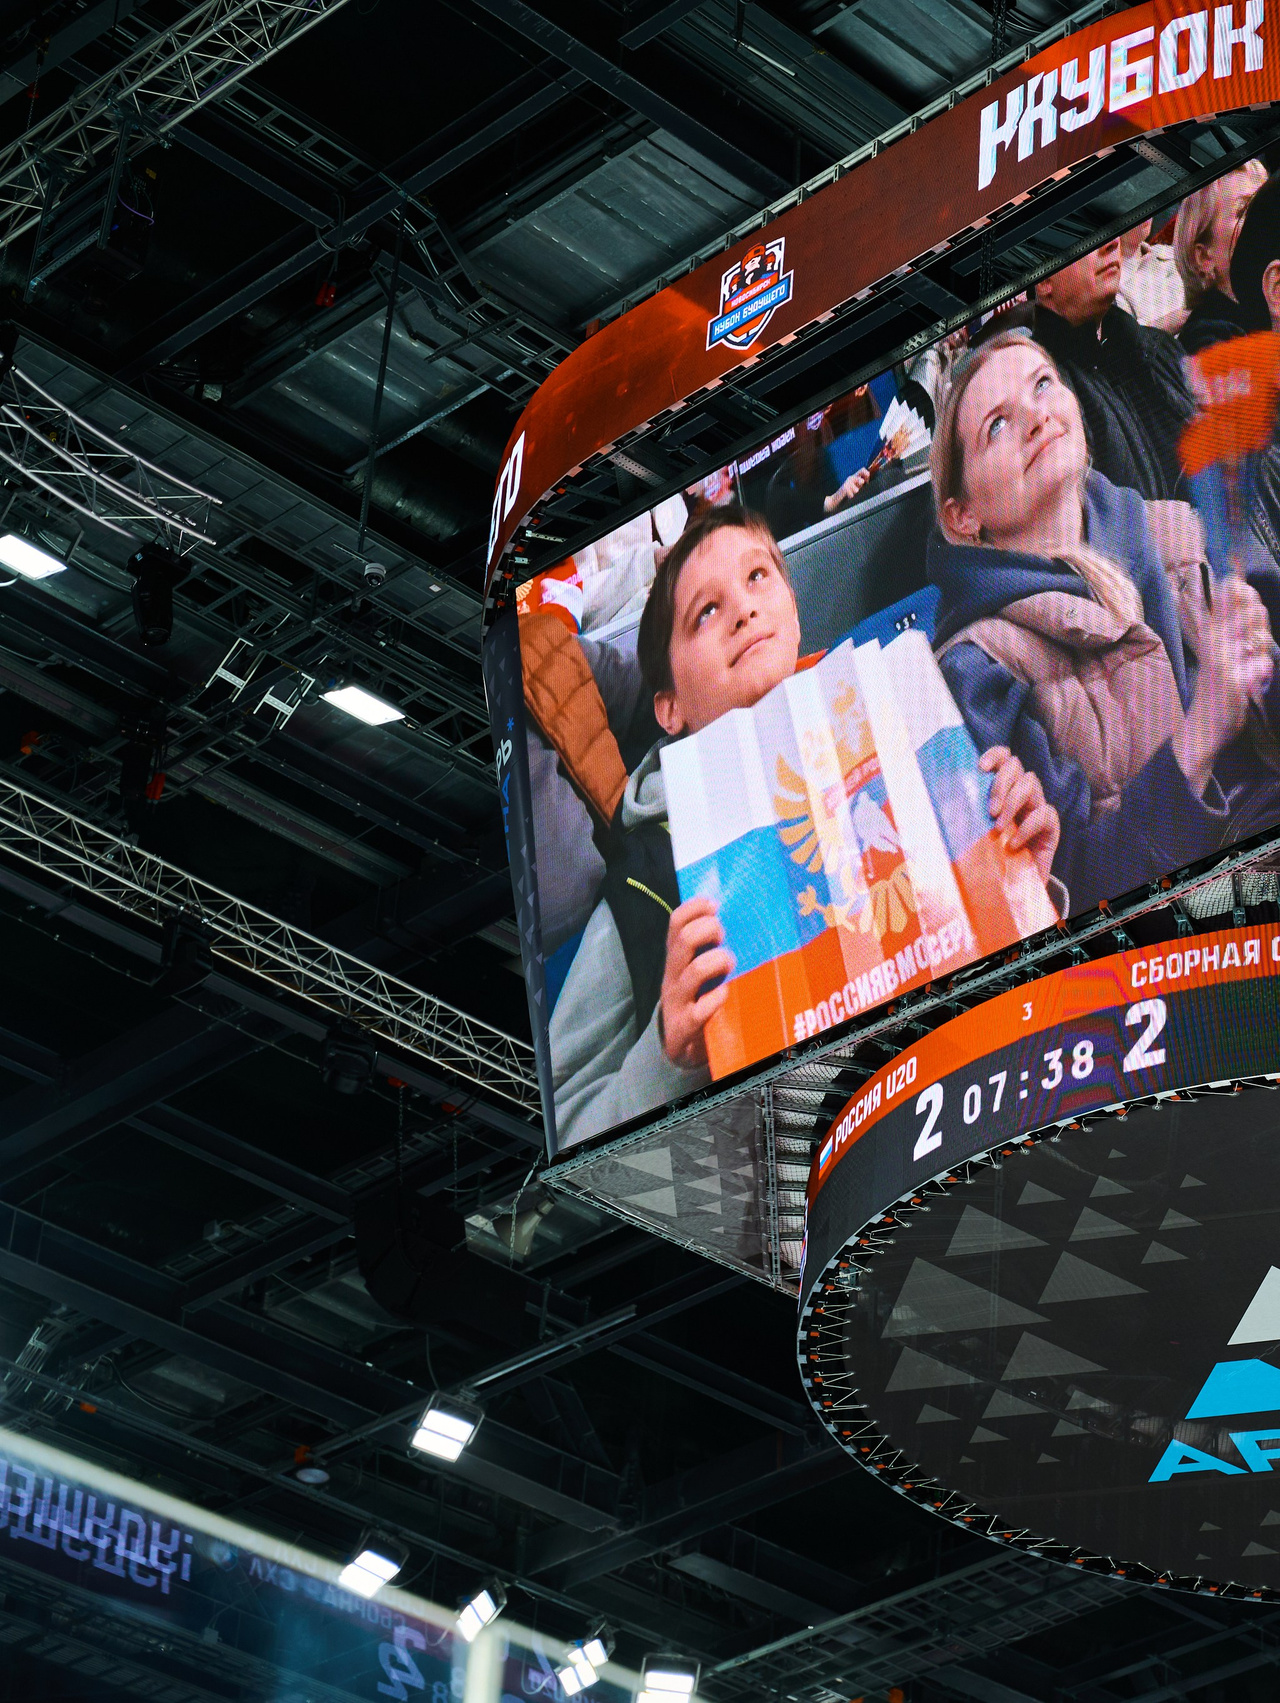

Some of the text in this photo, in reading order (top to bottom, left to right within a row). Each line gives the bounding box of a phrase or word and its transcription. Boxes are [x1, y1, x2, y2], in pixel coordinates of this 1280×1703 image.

[714, 285, 786, 336] КУБОК БУДУЩЕГО
[1131, 939, 1261, 988] СБОРНАЯ
[1021, 1002, 1033, 1021] 3
[1123, 998, 1167, 1073] 2
[834, 1056, 917, 1153] РОССИЯ U20
[963, 1039, 1094, 1125] 07:38
[913, 1082, 944, 1162] 2
